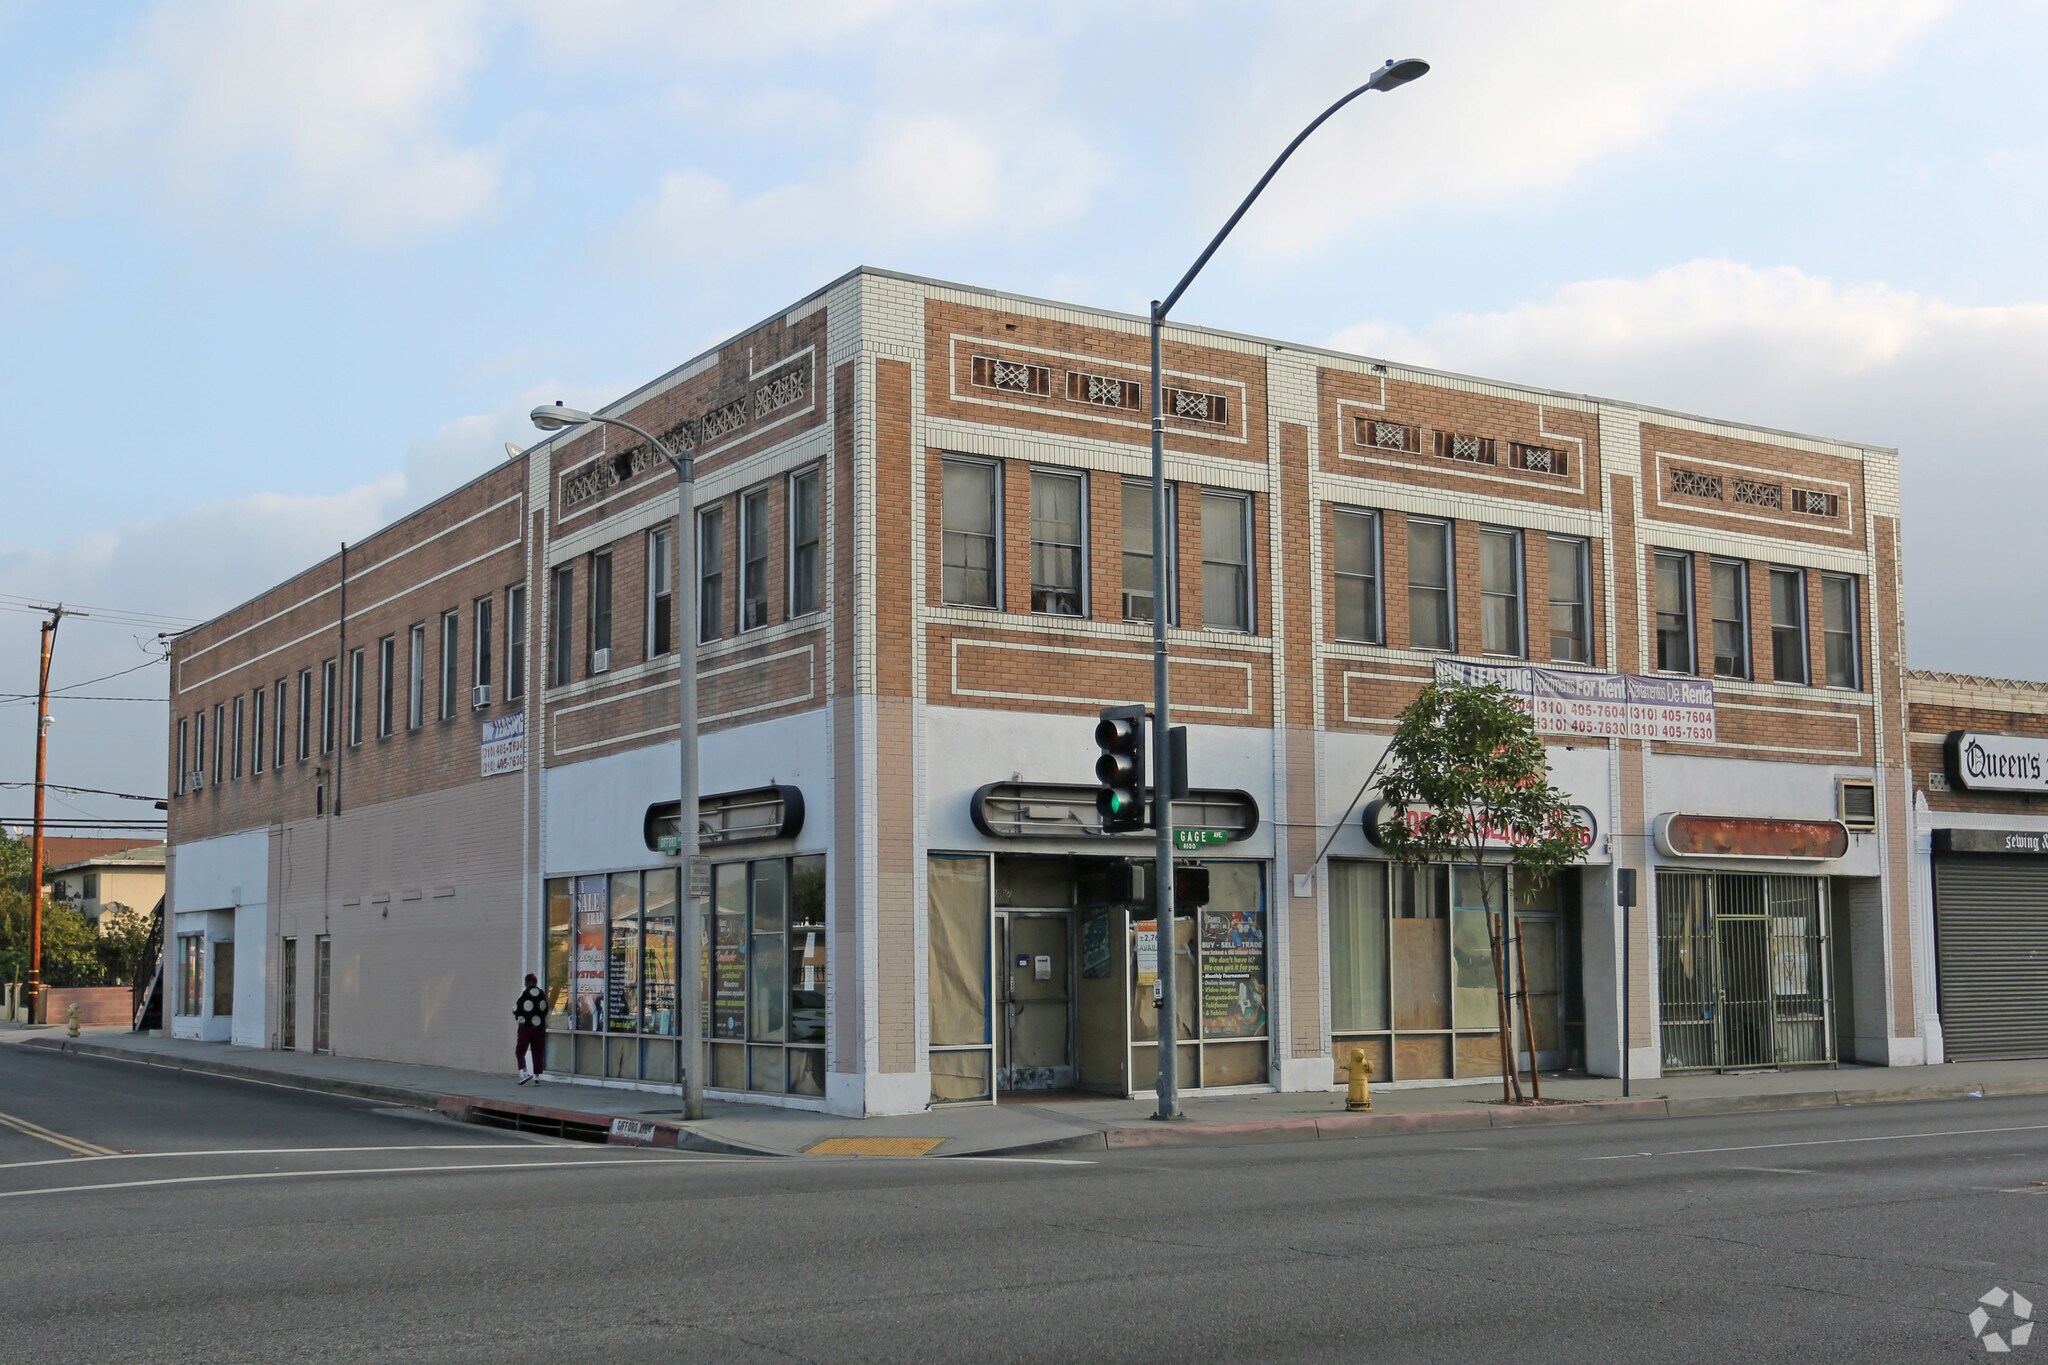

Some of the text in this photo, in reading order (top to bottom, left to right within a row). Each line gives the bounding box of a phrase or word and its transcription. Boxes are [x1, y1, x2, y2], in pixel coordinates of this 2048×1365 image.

[1471, 666, 1533, 692] LEASING
[1534, 675, 1626, 699] Apartments For Rent
[1628, 682, 1713, 705] Apartamentos De Renta
[1537, 701, 1566, 714] (310)
[1571, 704, 1625, 718] 405-7604
[1630, 707, 1712, 723] (310) 405-7604
[1571, 720, 1626, 735] 405-7630
[1631, 723, 1712, 739] (310) 405-7630
[1964, 736, 2040, 779] Queen's
[1180, 831, 1206, 842] GAGE
[2005, 833, 2039, 851] sewing
